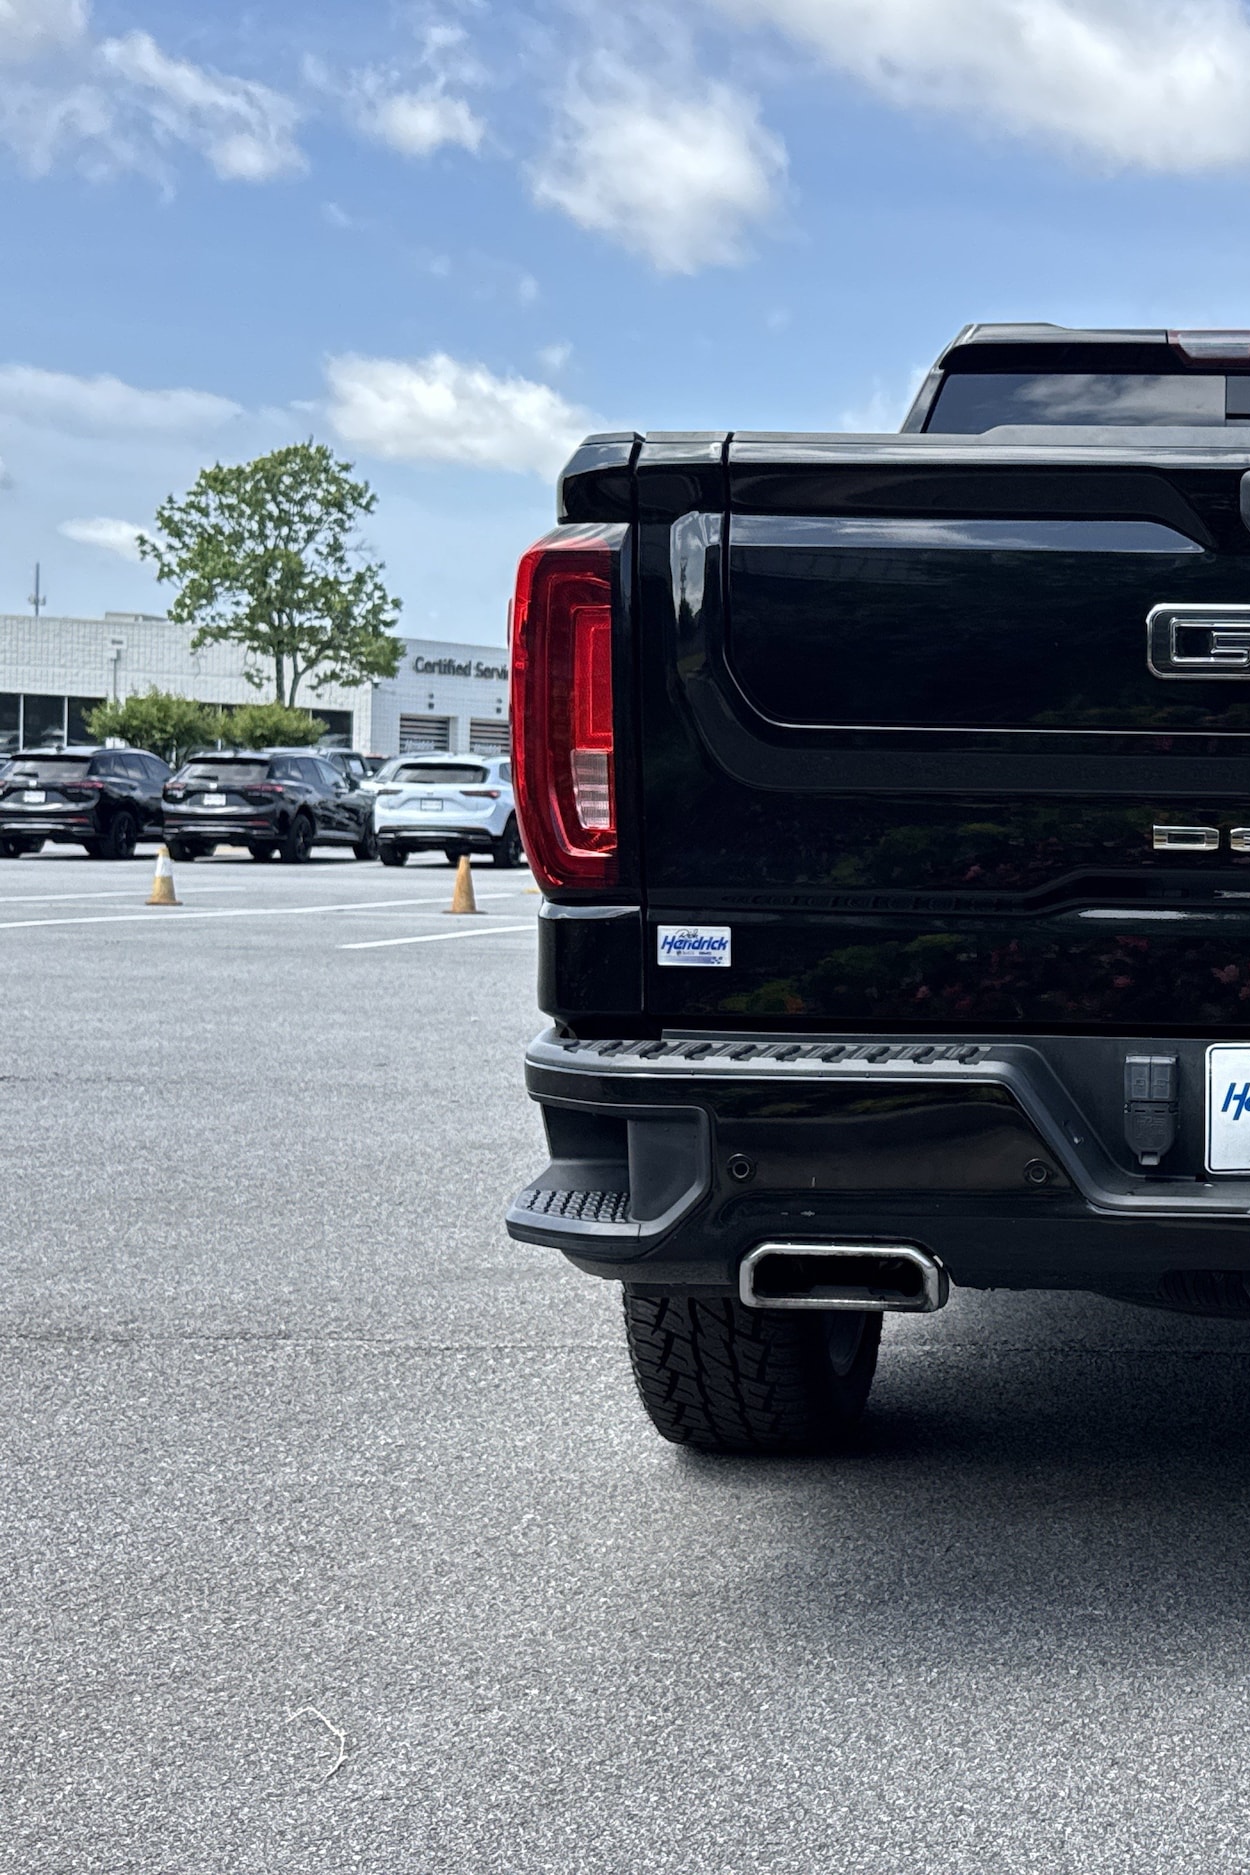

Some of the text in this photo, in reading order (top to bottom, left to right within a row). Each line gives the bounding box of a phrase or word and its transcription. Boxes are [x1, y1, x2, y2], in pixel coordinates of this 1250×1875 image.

[415, 656, 508, 680] Certified Servi
[661, 935, 728, 954] Hendrick
